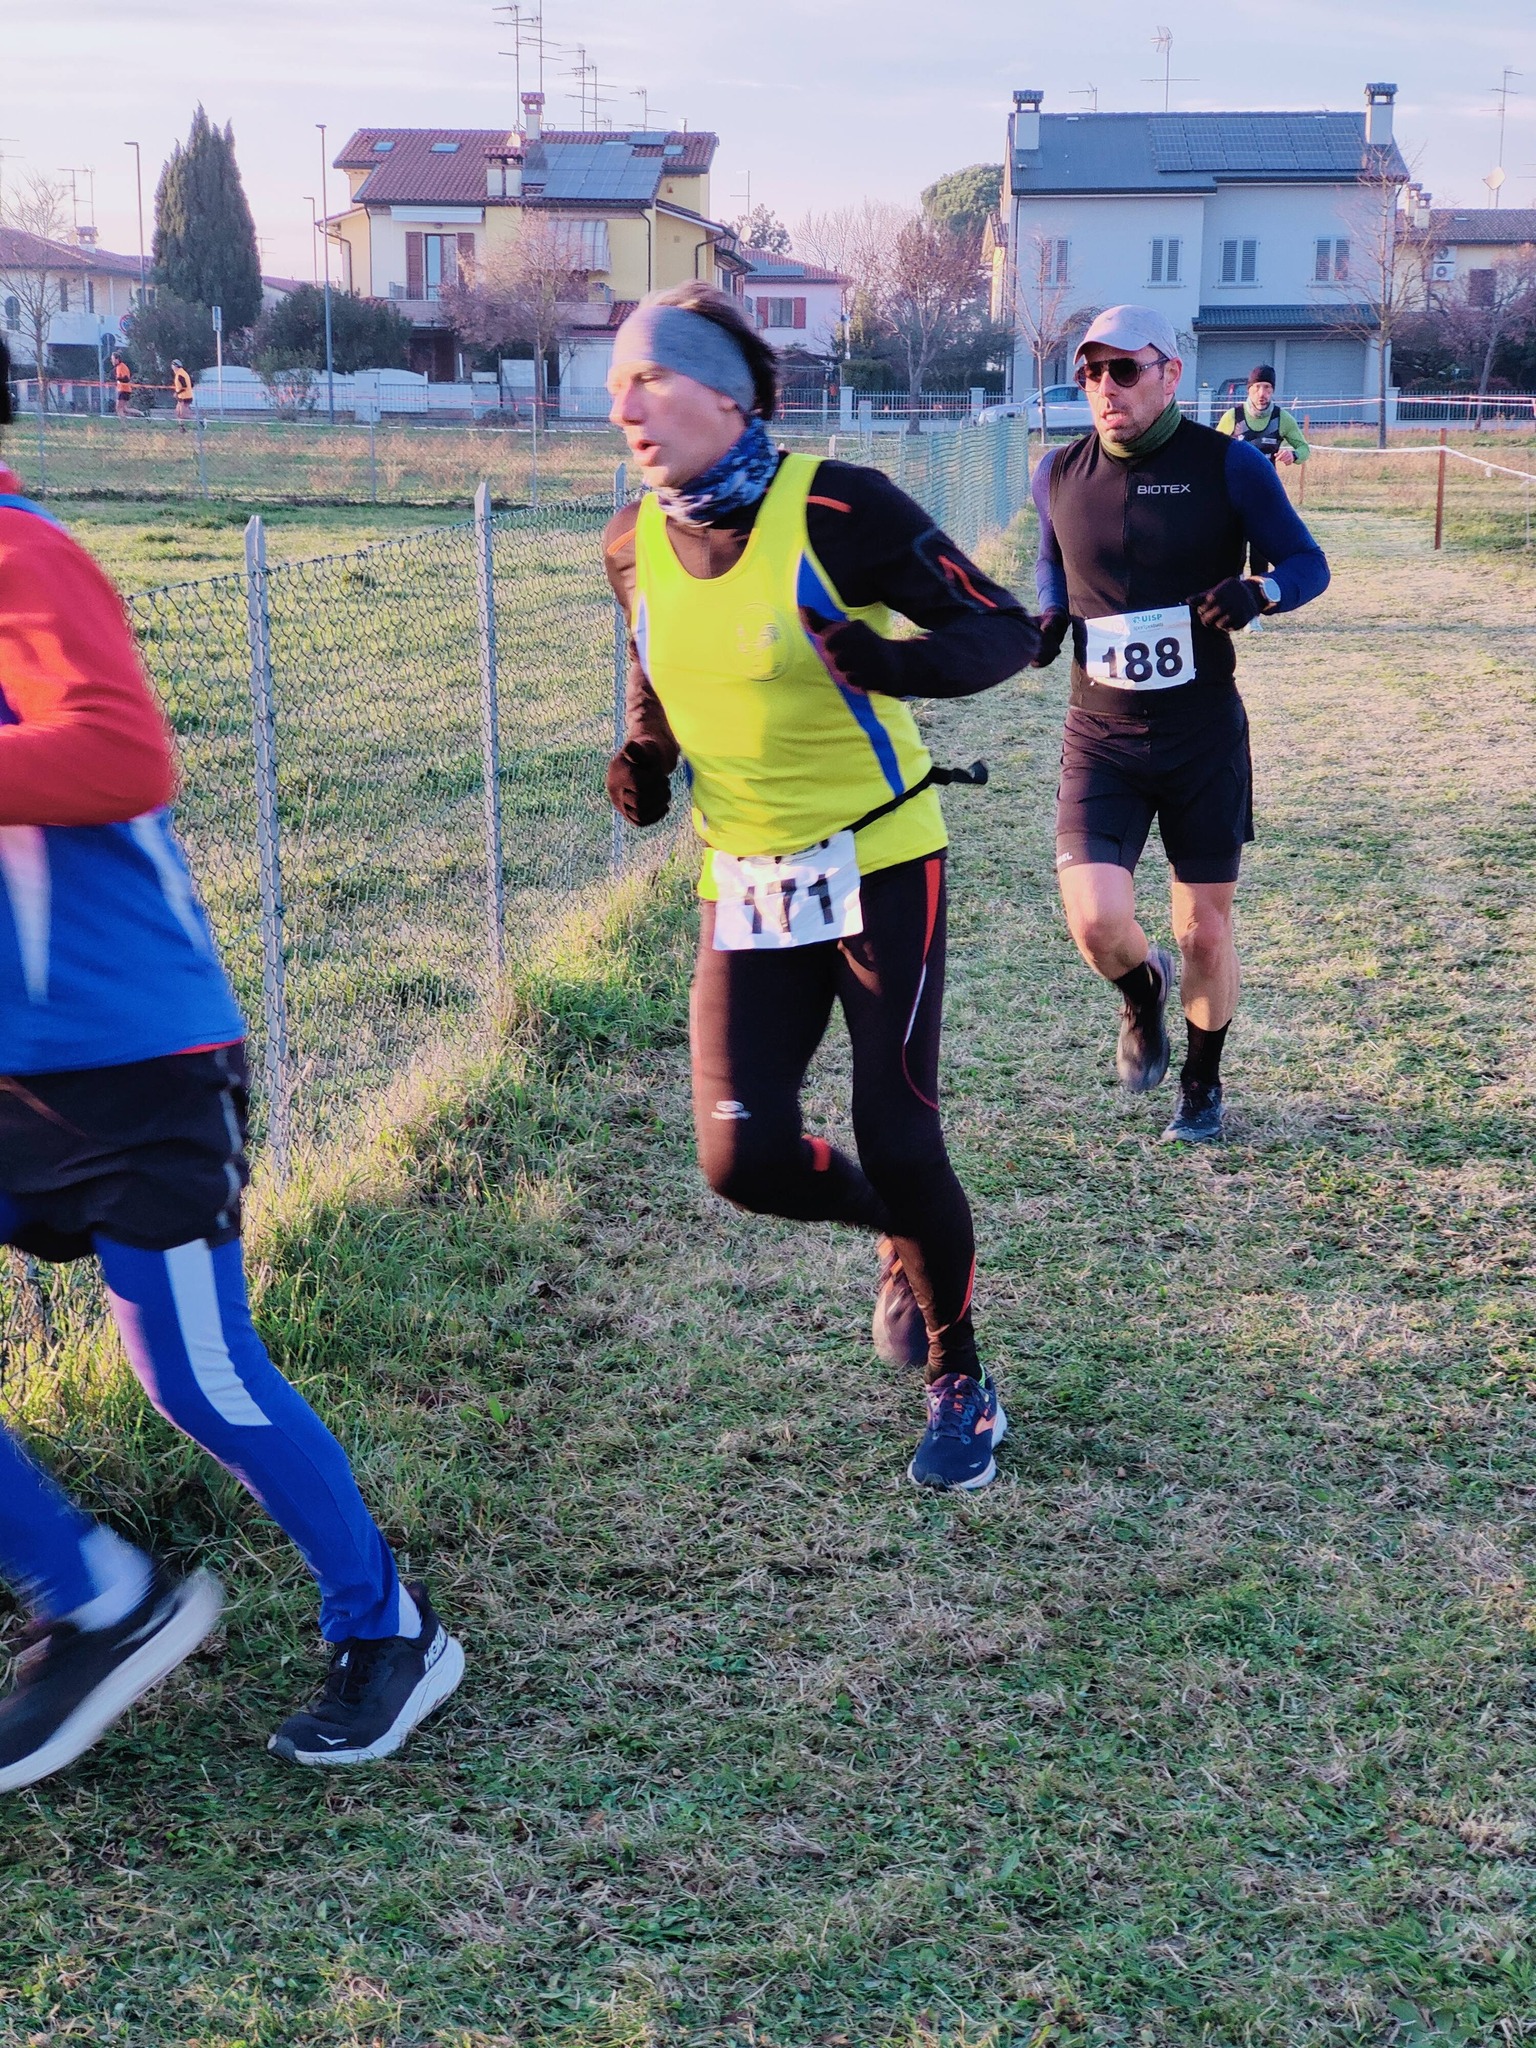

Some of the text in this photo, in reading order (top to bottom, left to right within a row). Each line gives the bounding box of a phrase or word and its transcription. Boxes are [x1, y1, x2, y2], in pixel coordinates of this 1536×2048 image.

[1137, 484, 1191, 495] BIOTEX
[1141, 613, 1163, 622] UISP
[1102, 637, 1183, 683] 188
[744, 873, 834, 934] 171
